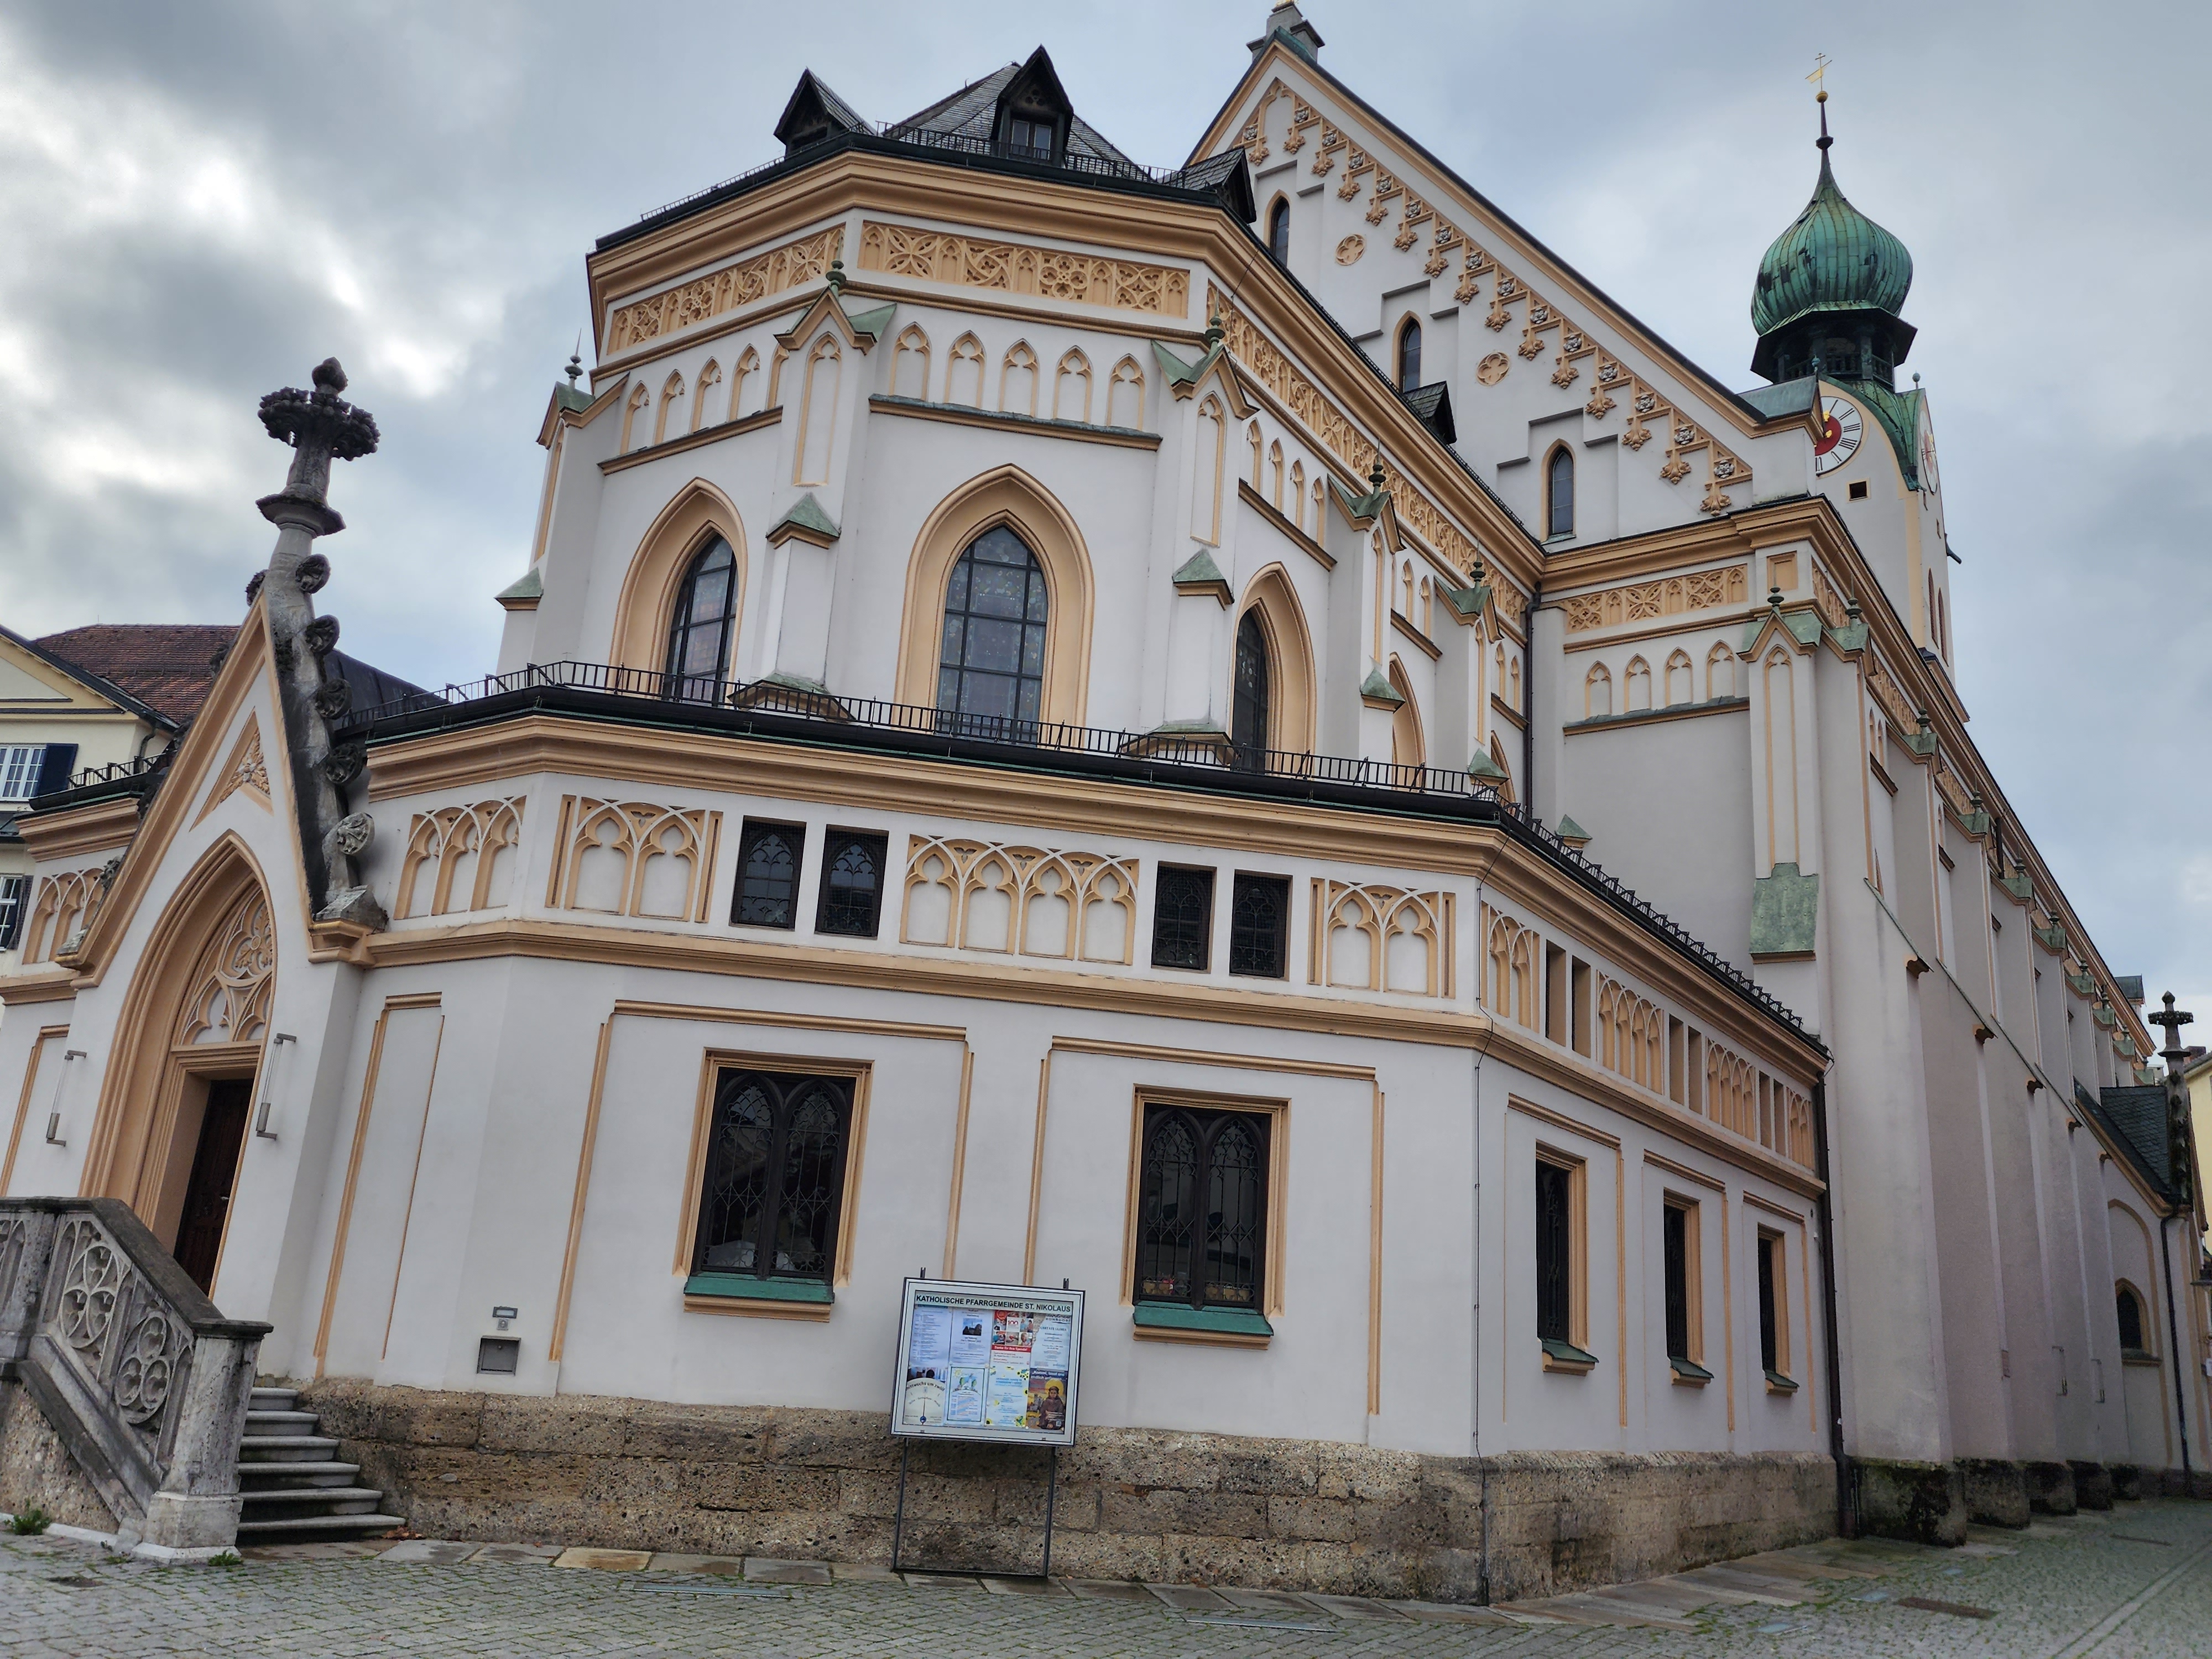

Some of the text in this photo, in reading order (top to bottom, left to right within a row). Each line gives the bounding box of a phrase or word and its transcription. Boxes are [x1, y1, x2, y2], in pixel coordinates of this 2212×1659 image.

[1843, 423, 1861, 432] III
[1838, 437, 1858, 450] IIII
[916, 1295, 964, 1305] KATHOLISCHE
[966, 1298, 1023, 1309] PFARRGEMEINDE
[1036, 1304, 1071, 1312] NIKOLAUS
